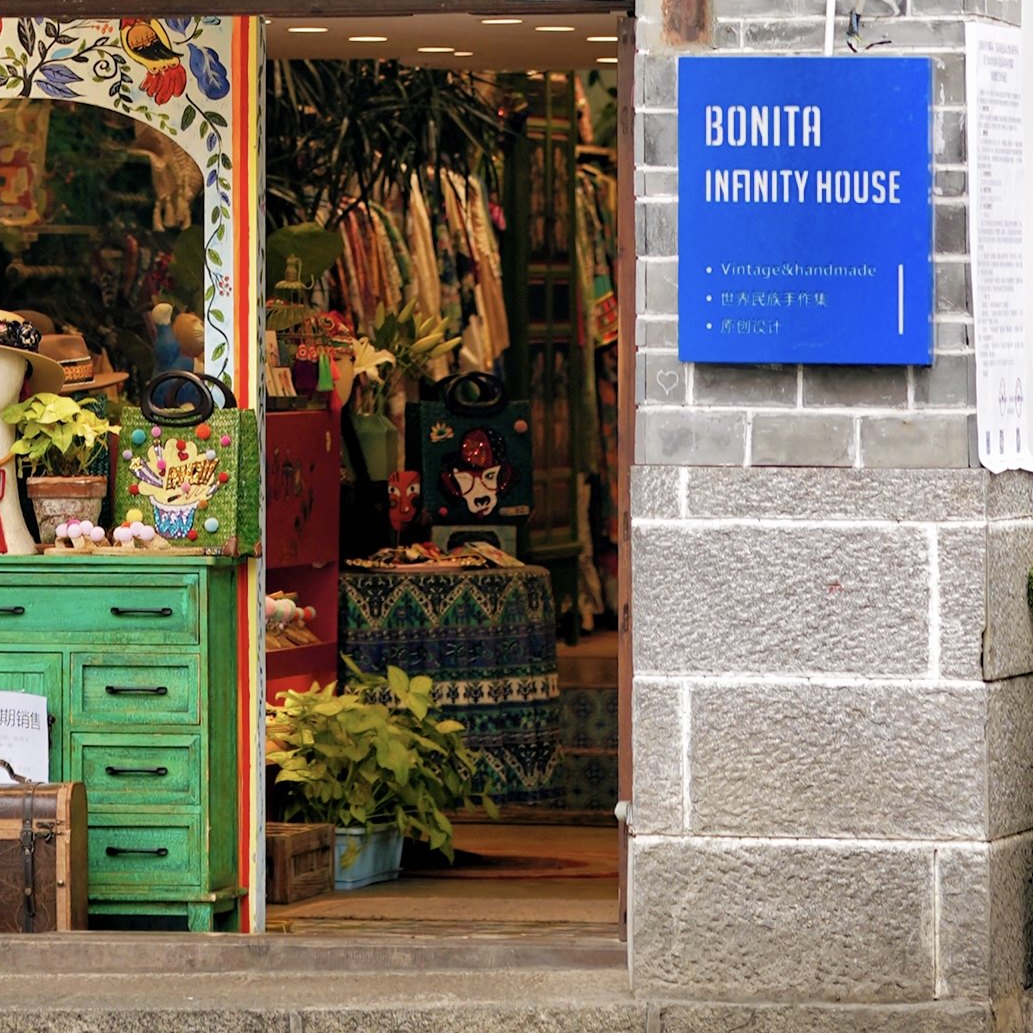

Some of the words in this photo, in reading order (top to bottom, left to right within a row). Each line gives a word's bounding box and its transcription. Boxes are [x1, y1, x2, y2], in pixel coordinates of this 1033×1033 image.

[705, 105, 821, 147] BONITA
[705, 169, 809, 203] INFINITY
[816, 170, 901, 204] HOUSE
[720, 262, 877, 279] Vintage&handmade
[720, 291, 828, 308] 世界民族手作集
[720, 319, 781, 335] 原创设计
